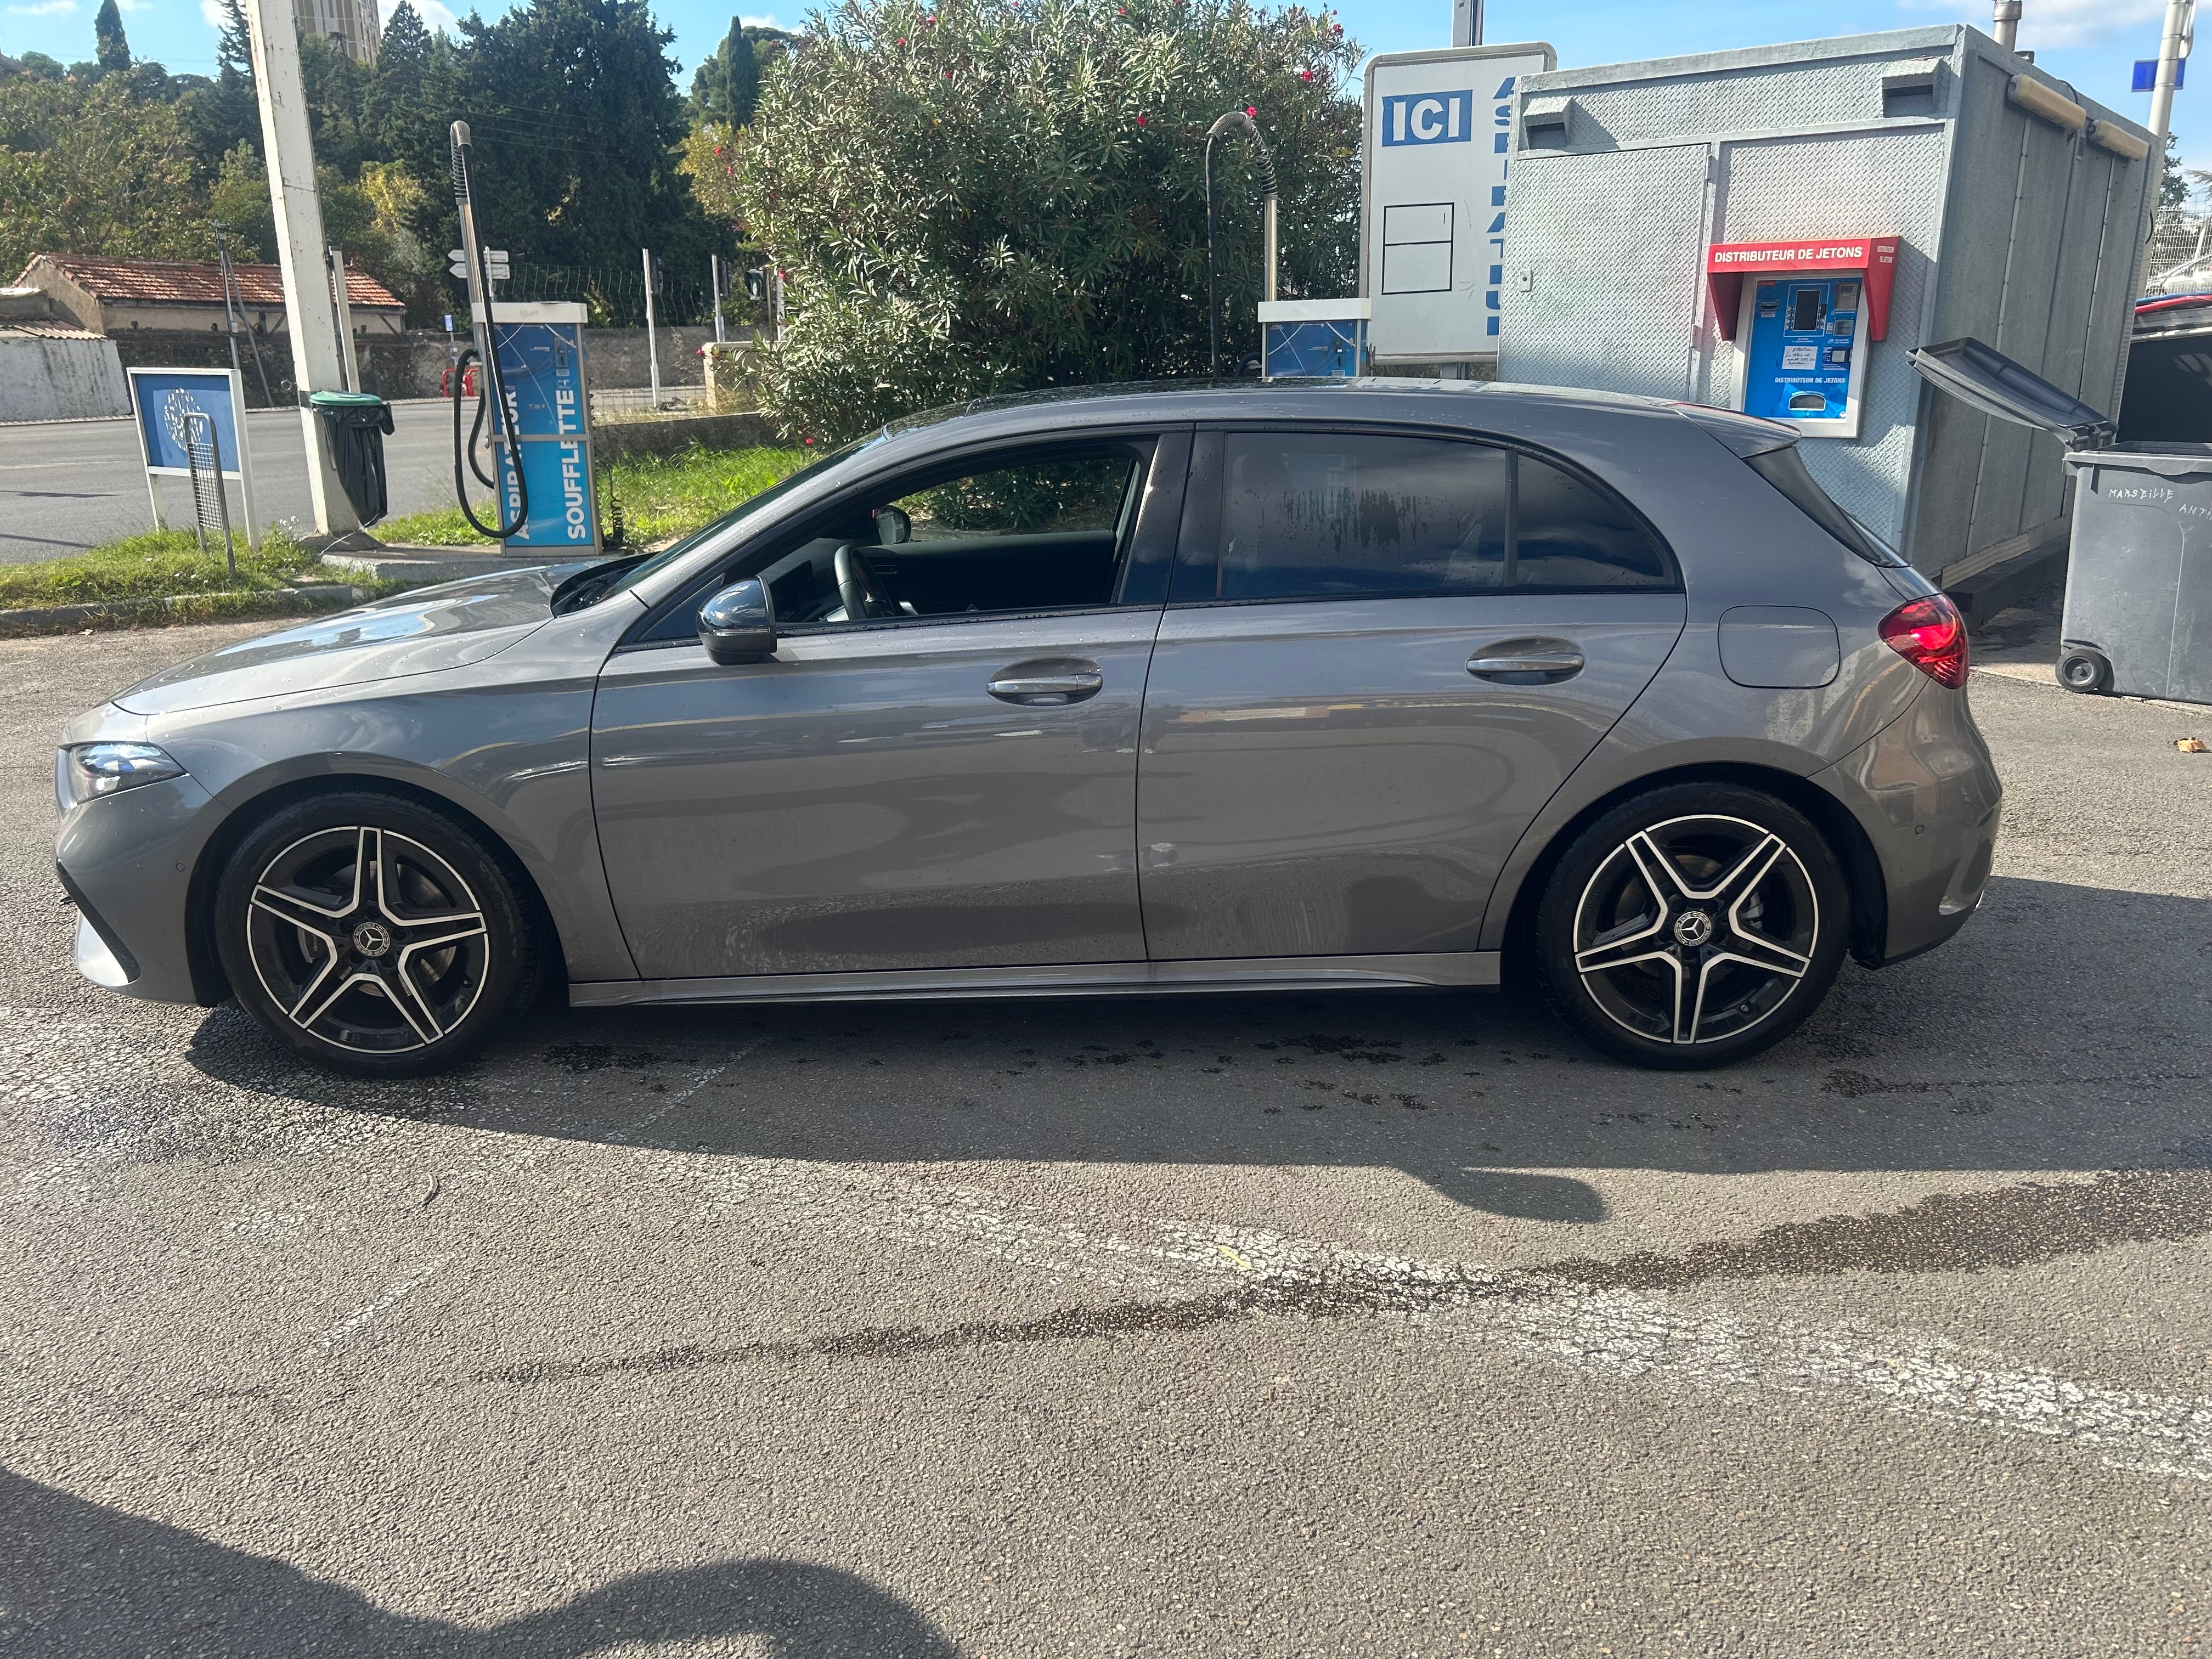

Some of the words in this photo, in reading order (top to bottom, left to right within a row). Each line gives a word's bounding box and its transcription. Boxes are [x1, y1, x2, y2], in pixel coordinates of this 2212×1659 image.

[1392, 98, 1460, 142] ICI
[1714, 249, 1795, 263] DISTRIBUTEUR
[1797, 249, 1814, 260] DE
[1815, 246, 1863, 259] JETONS
[555, 390, 586, 539] SOUFFLETTE
